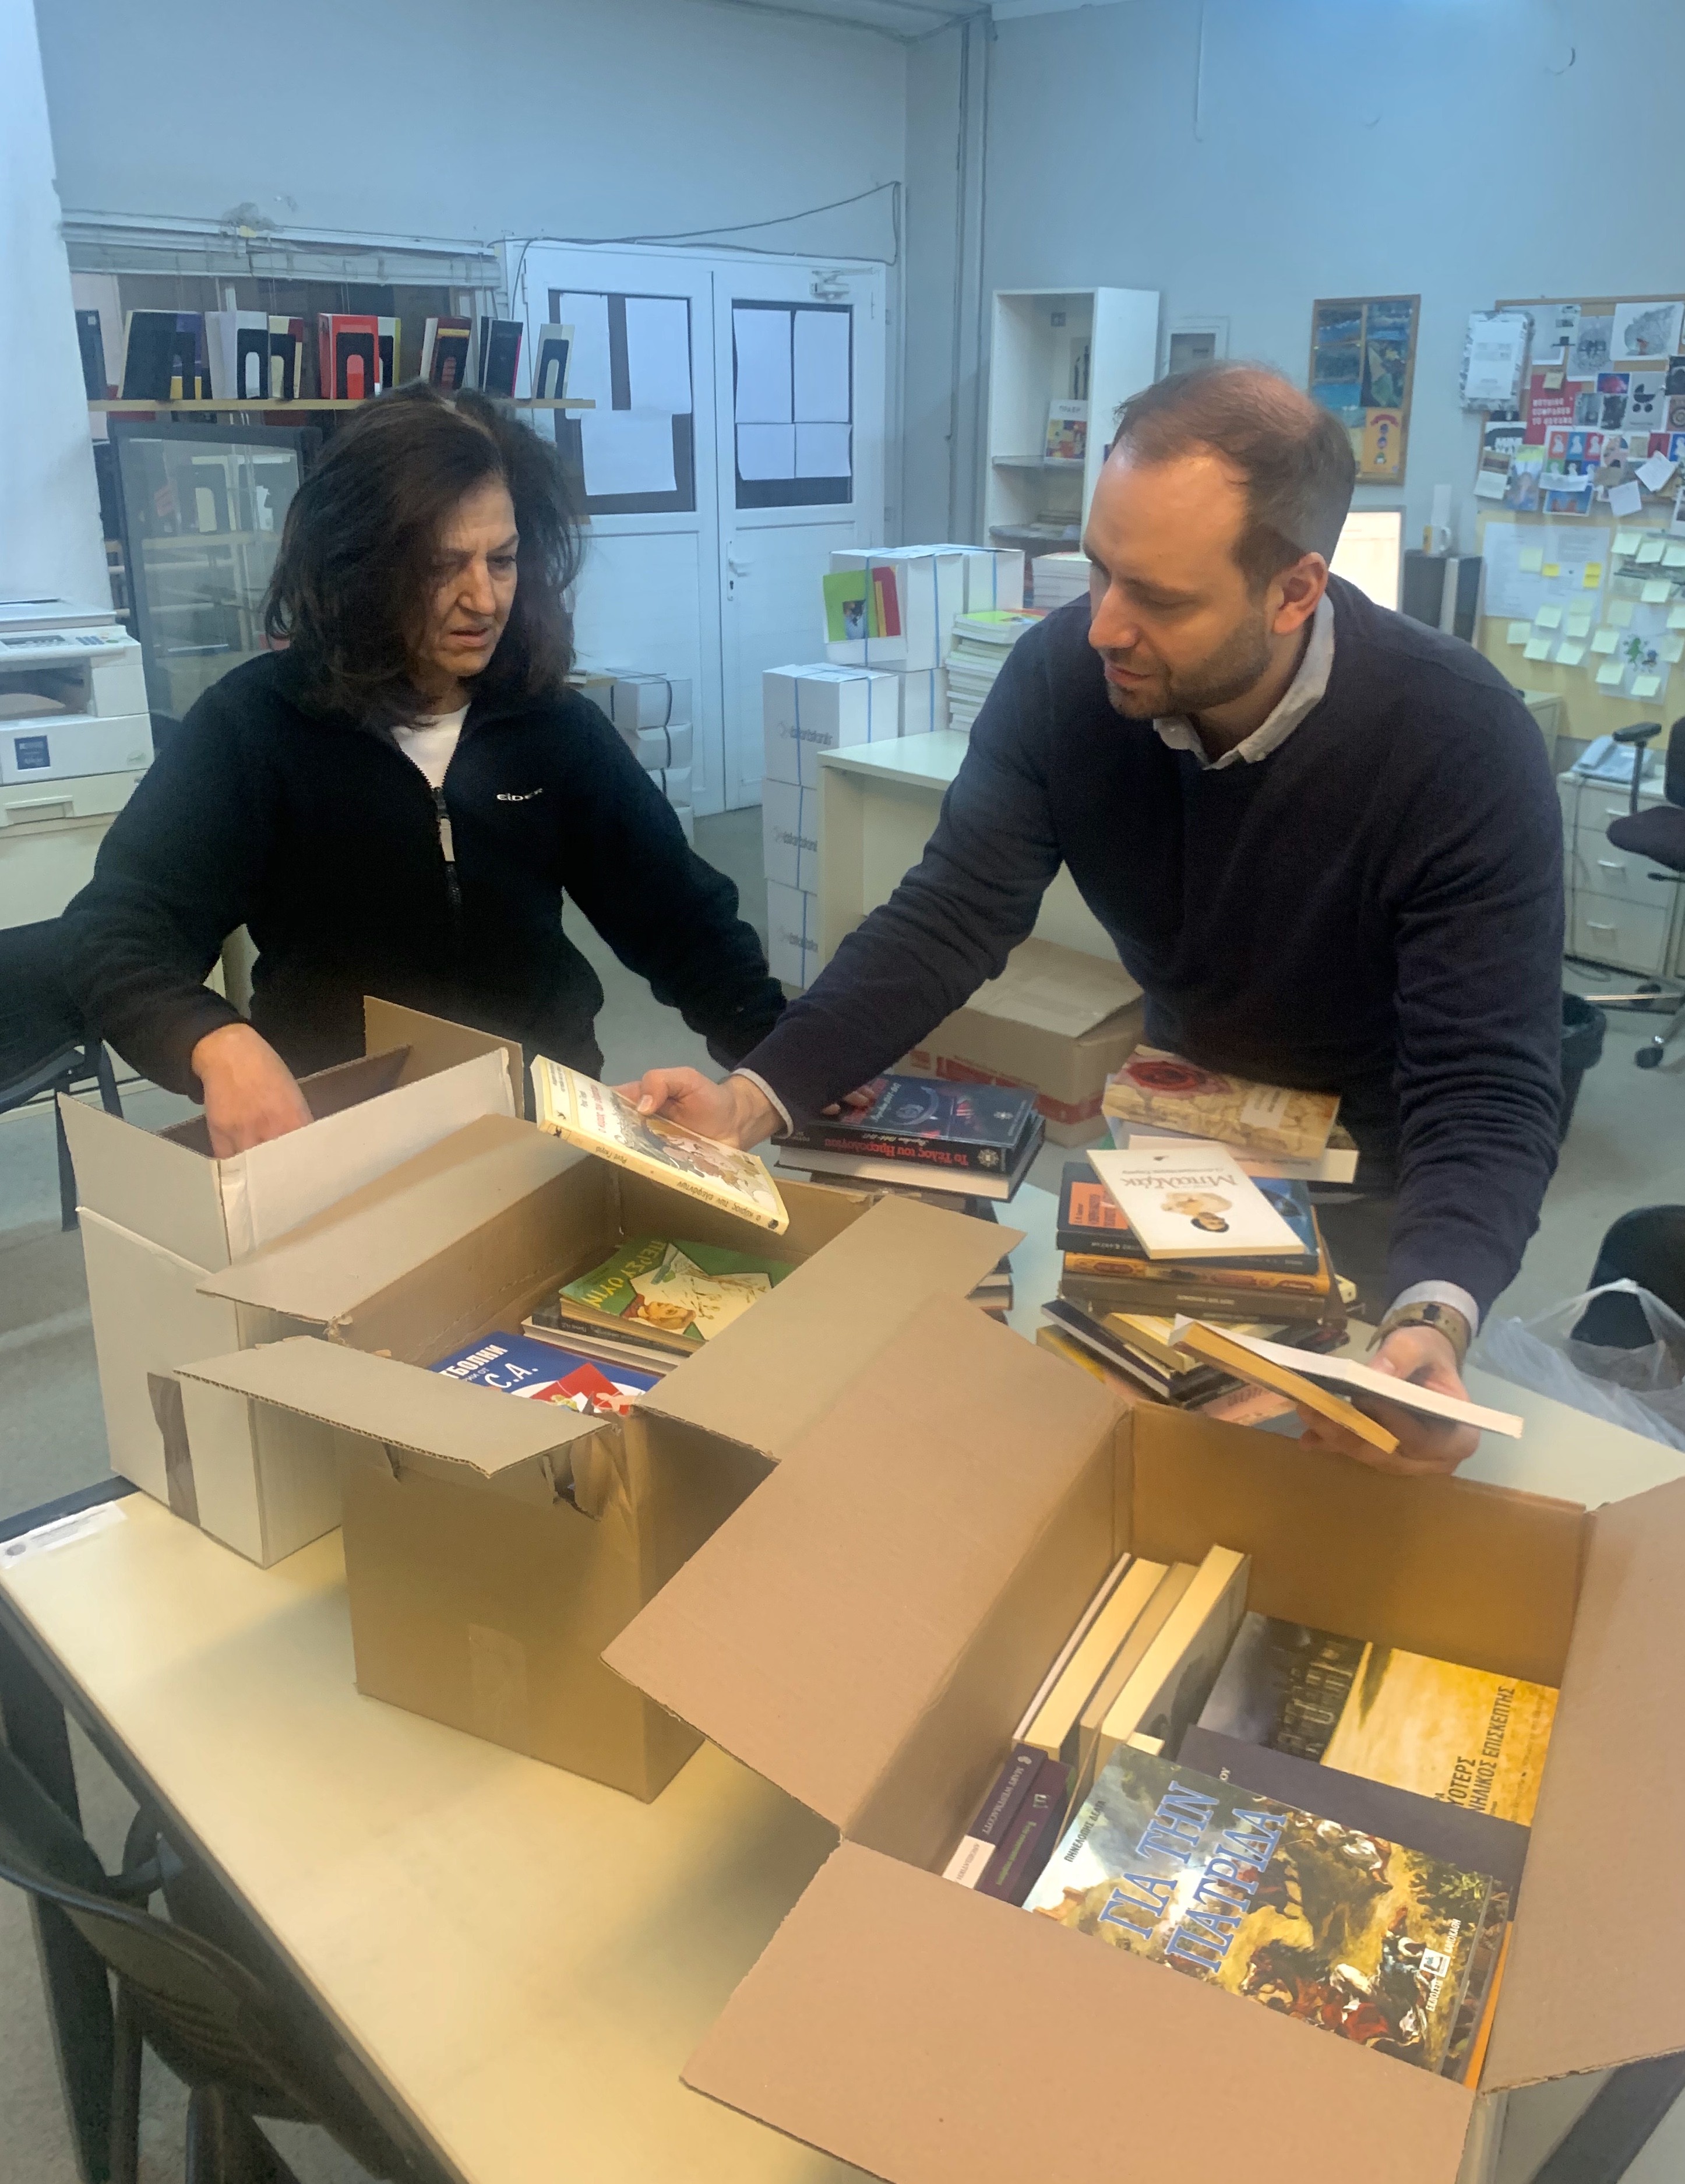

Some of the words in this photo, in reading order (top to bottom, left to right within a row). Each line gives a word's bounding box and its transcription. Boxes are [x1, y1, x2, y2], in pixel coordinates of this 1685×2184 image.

[896, 1145, 915, 1157] του
[953, 1152, 968, 1166] Το
[1120, 1173, 1238, 1188] Μπαλζάκ
[1482, 1686, 1515, 1758] ΕΠΙΣΚΕΠΤΗΣ
[1064, 1816, 1098, 1863] ΠΗΝΕΛΟΠΗΣ
[1091, 1799, 1108, 1823] ΔΕΛΤΑ
[1136, 1780, 1221, 1866] ΤΗΝ
[1098, 1868, 1178, 1940] ΓΙΑ
[1164, 1807, 1286, 1974] ΠΑΤΡΙΔΑ
